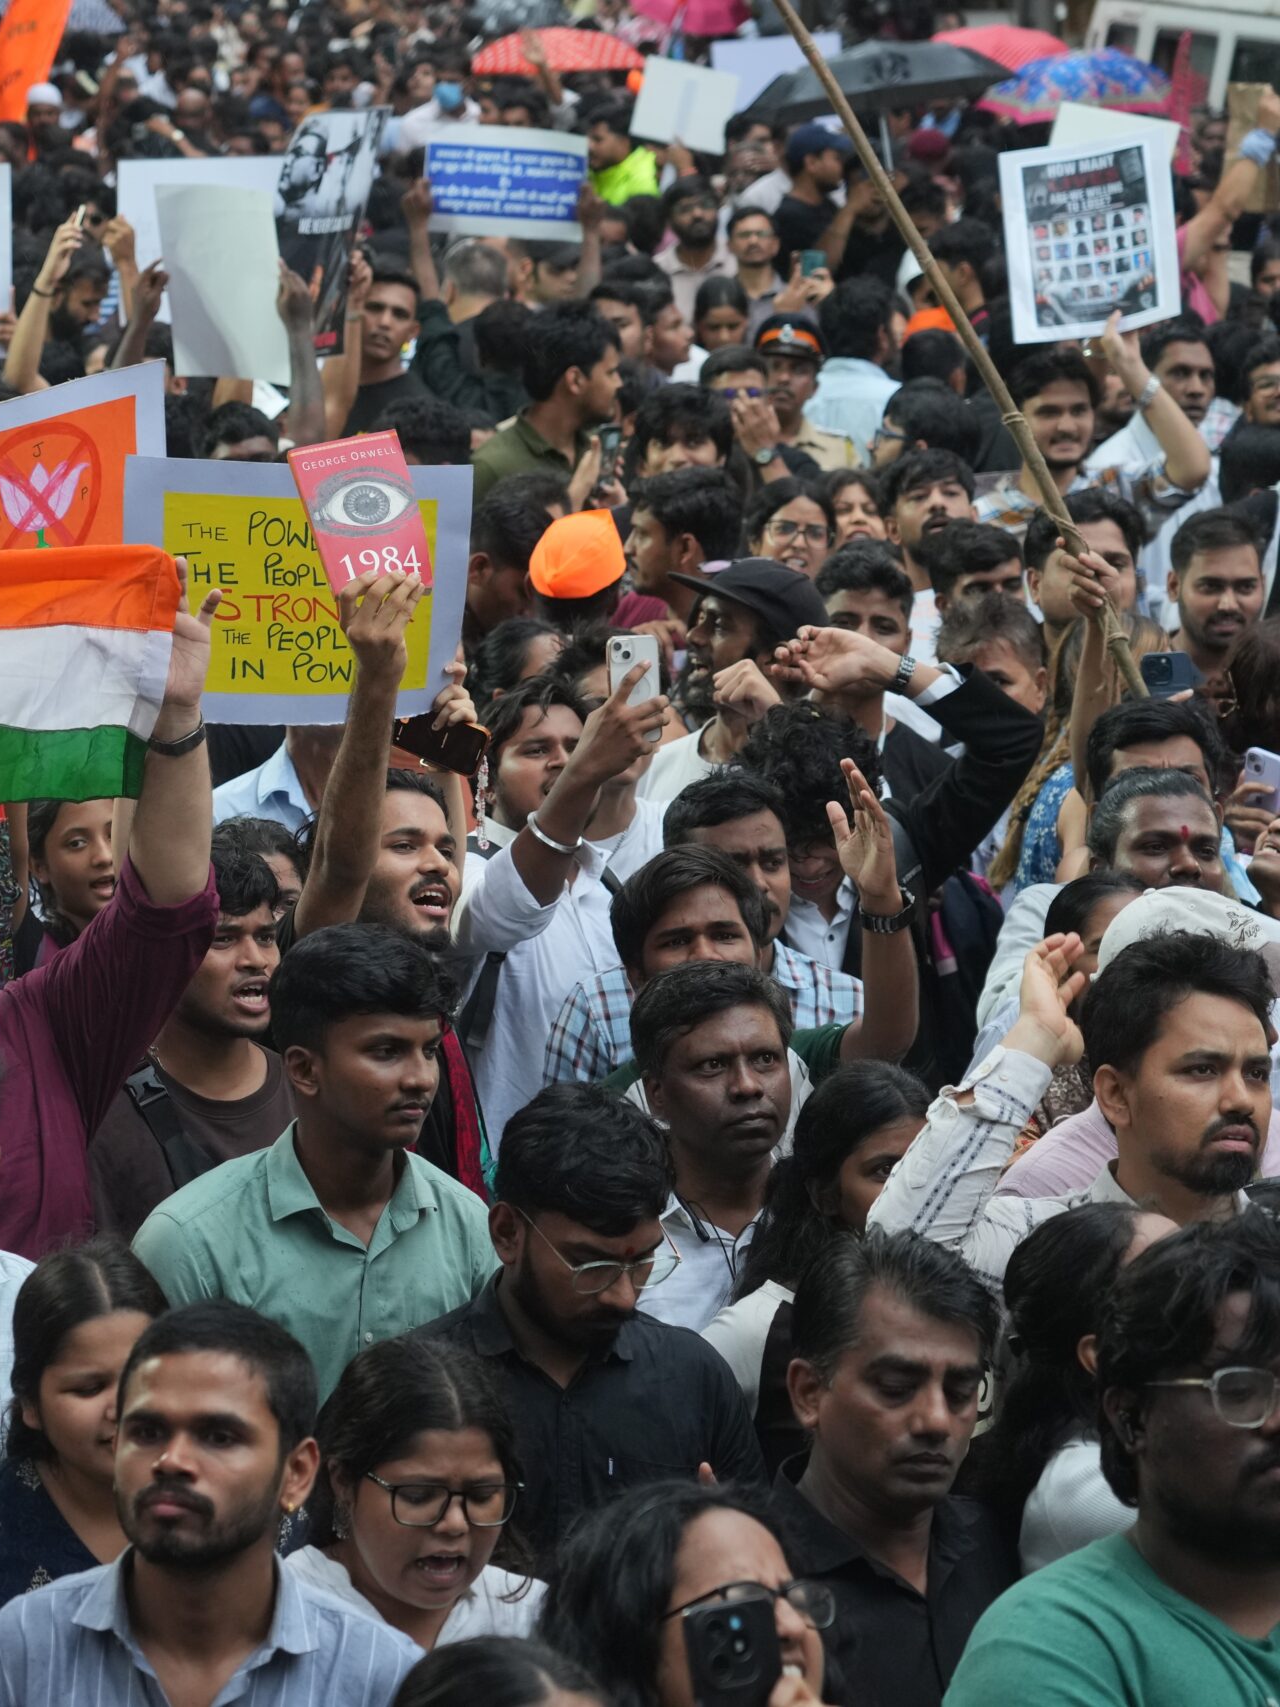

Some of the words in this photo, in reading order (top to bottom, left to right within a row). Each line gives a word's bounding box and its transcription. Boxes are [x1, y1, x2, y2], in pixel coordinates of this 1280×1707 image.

[1047, 161, 1077, 179] HOW
[1078, 153, 1115, 174] MANY
[1066, 200, 1081, 213] TO
[32, 441, 45, 458] J
[302, 455, 347, 471] GEORGE
[351, 447, 397, 461] ORWELL
[80, 486, 89, 500] P
[182, 522, 229, 541] THE
[248, 510, 318, 551] POW
[263, 552, 327, 587] PEOPL
[339, 544, 422, 582] 1984
[214, 588, 341, 624] STRON
[222, 629, 252, 645] THE
[267, 622, 348, 652] PEOPL
[230, 656, 265, 680] IN
[292, 652, 352, 683] POW
